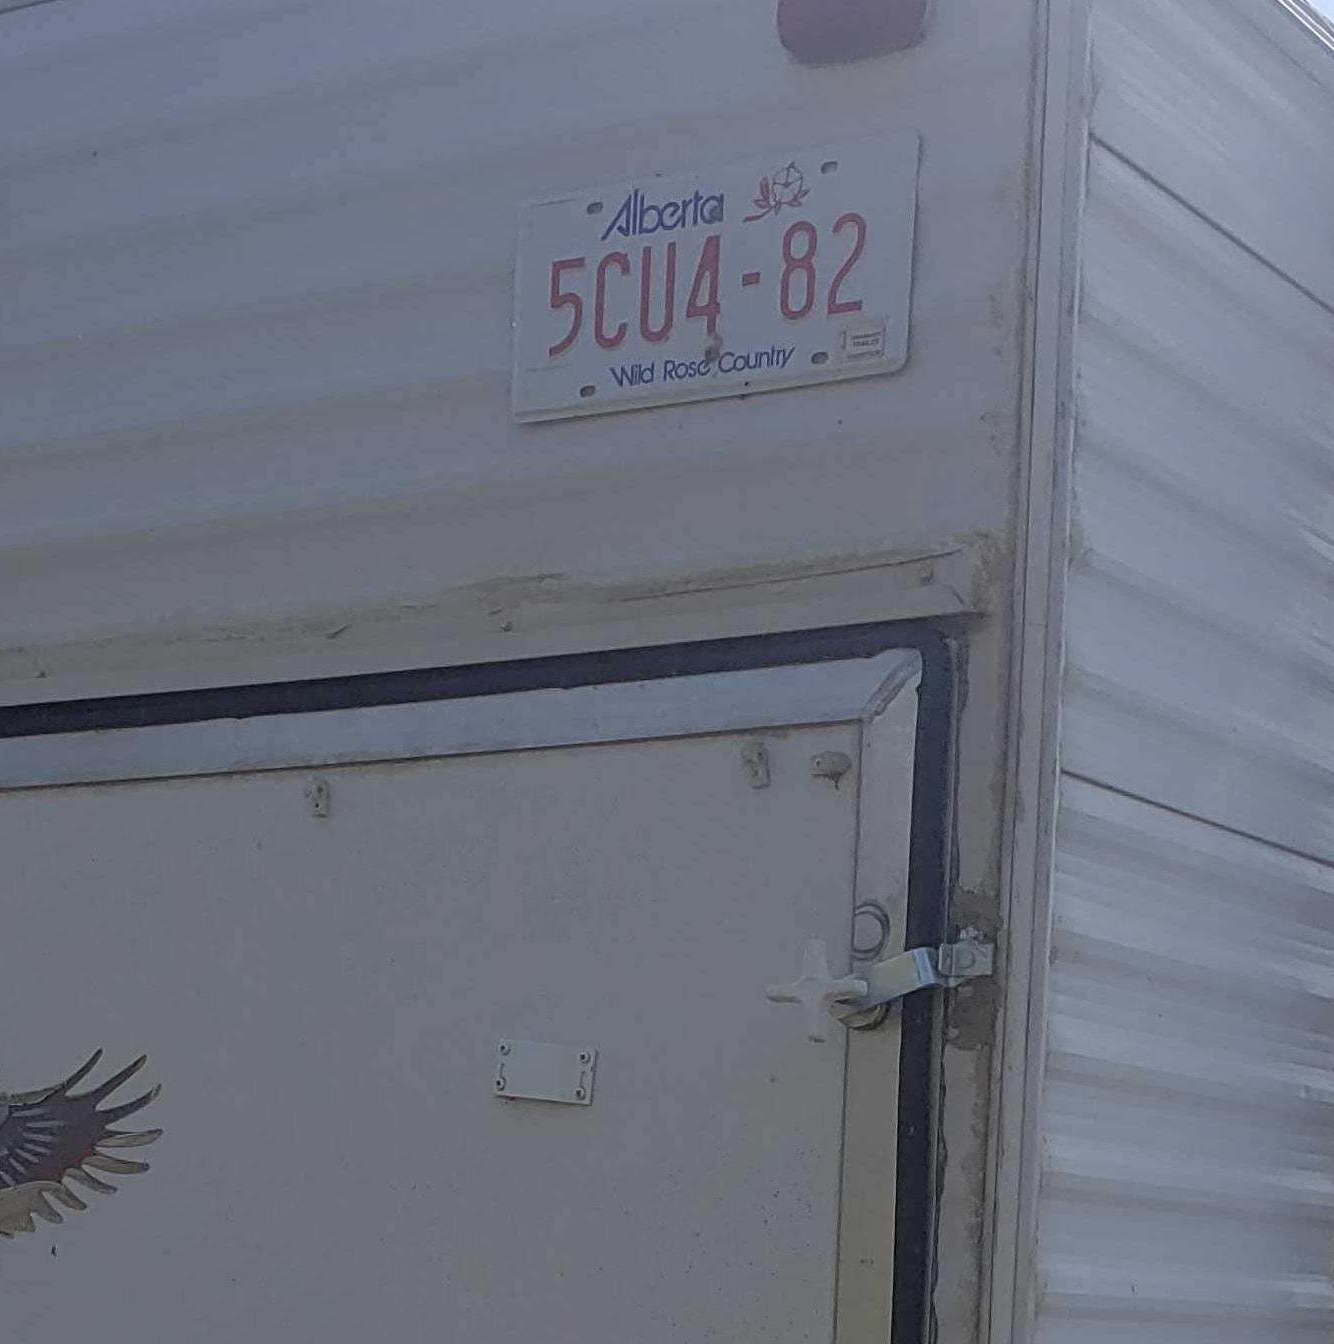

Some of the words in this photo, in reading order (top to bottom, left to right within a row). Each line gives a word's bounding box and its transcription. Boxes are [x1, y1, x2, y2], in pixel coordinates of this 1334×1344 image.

[601, 188, 724, 241] Alberta
[548, 212, 867, 358] 5CU4-82
[610, 362, 655, 388] Wild
[663, 358, 711, 381] Rose
[717, 345, 796, 376] Country
